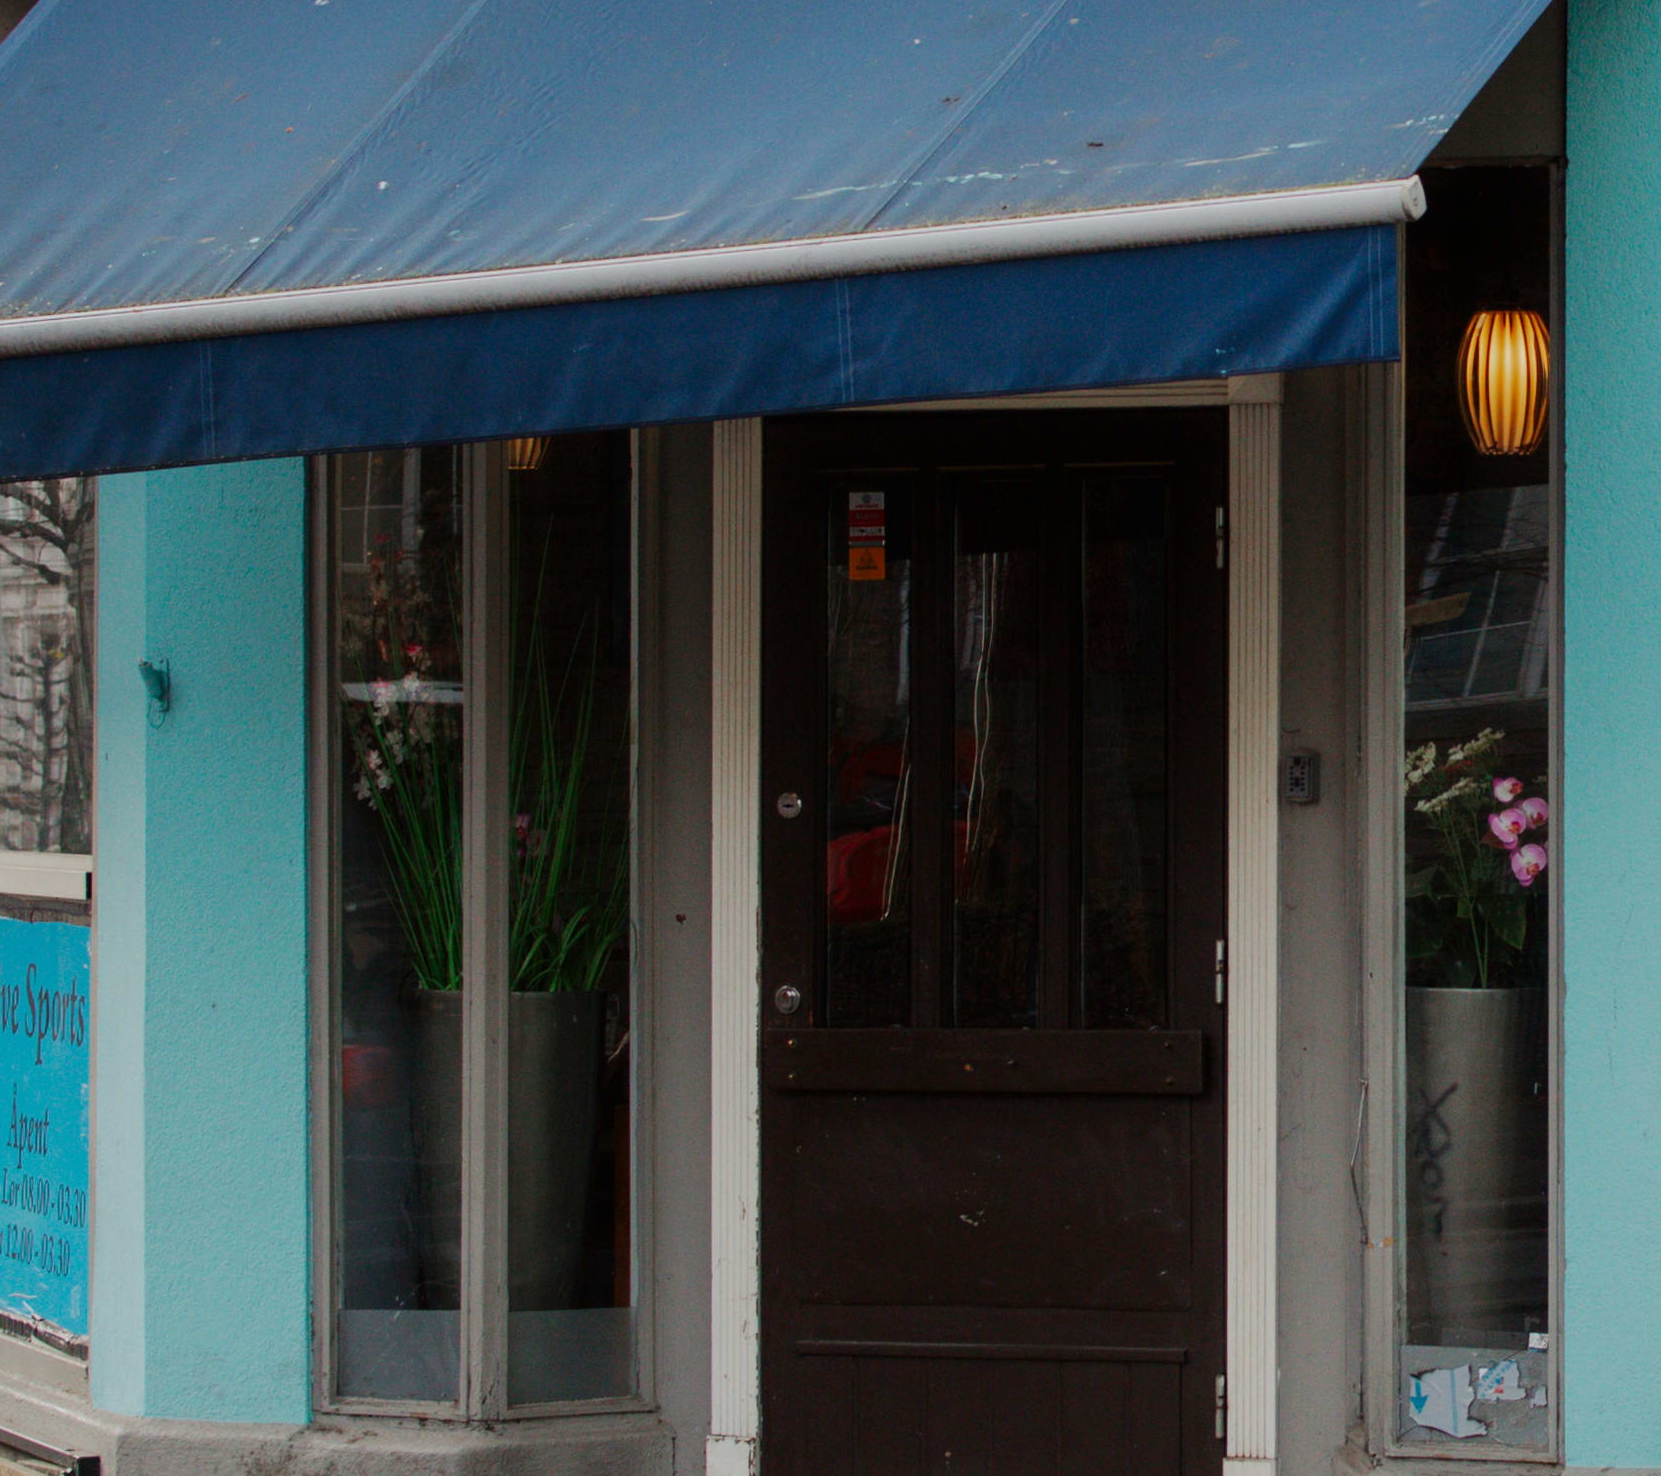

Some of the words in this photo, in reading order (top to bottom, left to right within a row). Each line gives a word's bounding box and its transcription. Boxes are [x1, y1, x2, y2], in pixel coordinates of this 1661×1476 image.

[25, 963, 85, 1065] Sports
[7, 1082, 49, 1169] Åpent
[22, 1174, 49, 1216] 08.00
[58, 1184, 86, 1228] 03.30
[5, 1224, 33, 1264] 12.00
[41, 1233, 70, 1277] 03.30
